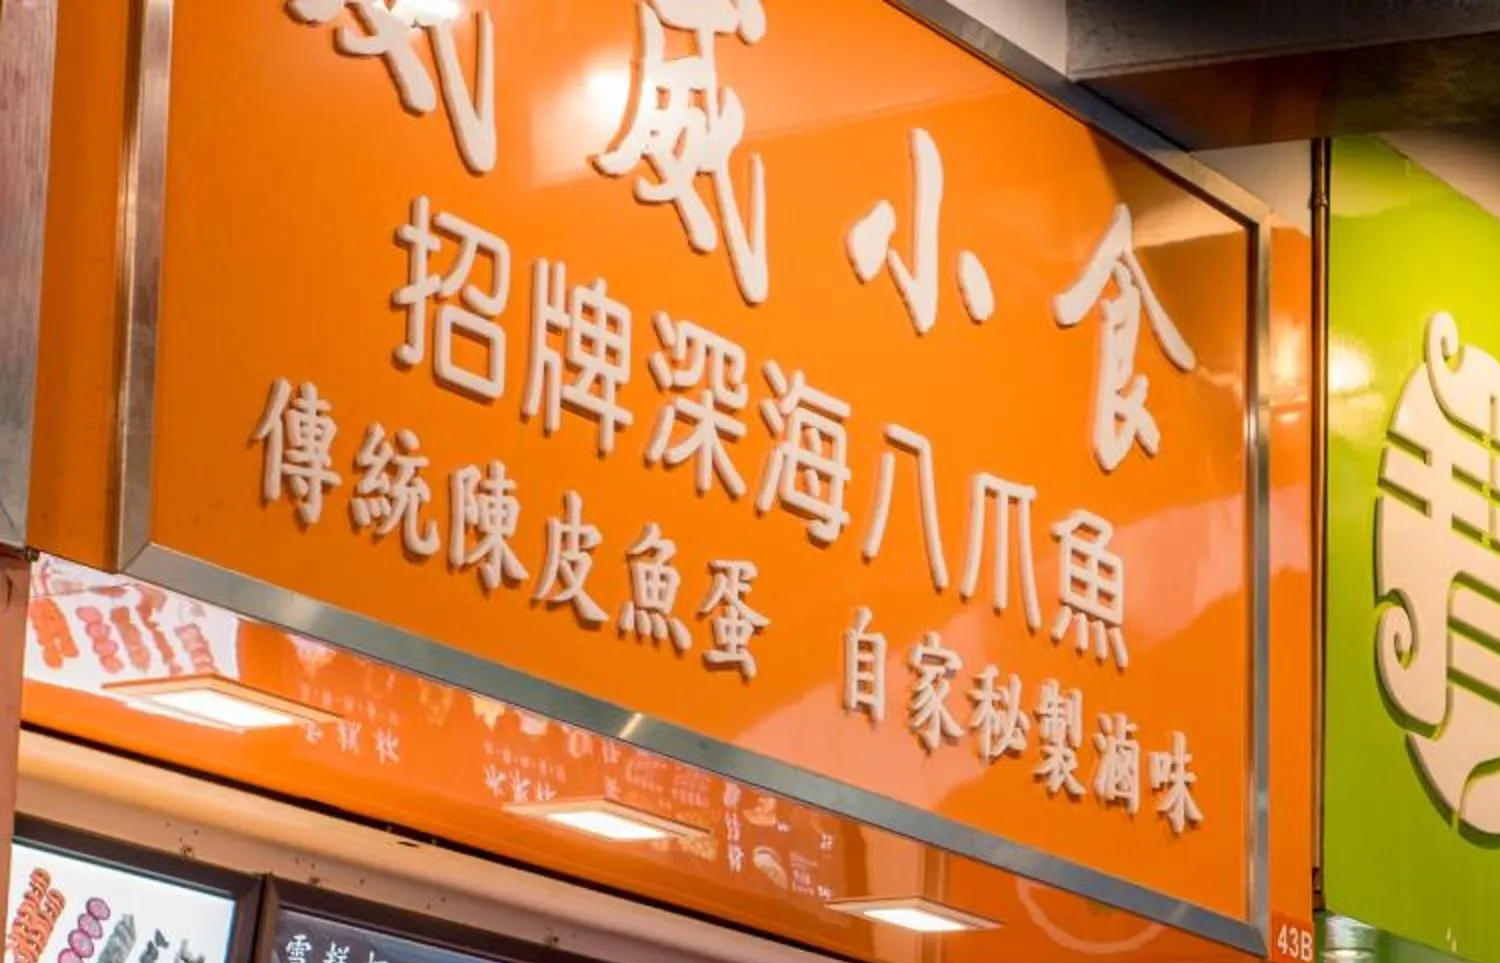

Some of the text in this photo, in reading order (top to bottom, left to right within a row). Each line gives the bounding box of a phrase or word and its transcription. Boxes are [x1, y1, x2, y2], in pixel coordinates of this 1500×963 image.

[255, 378, 1204, 833] 傳統陳皮魚蛋 自家秘製滷味
[394, 196, 1130, 669] 招牌深海八爪魚
[1277, 923, 1313, 962] 43B
